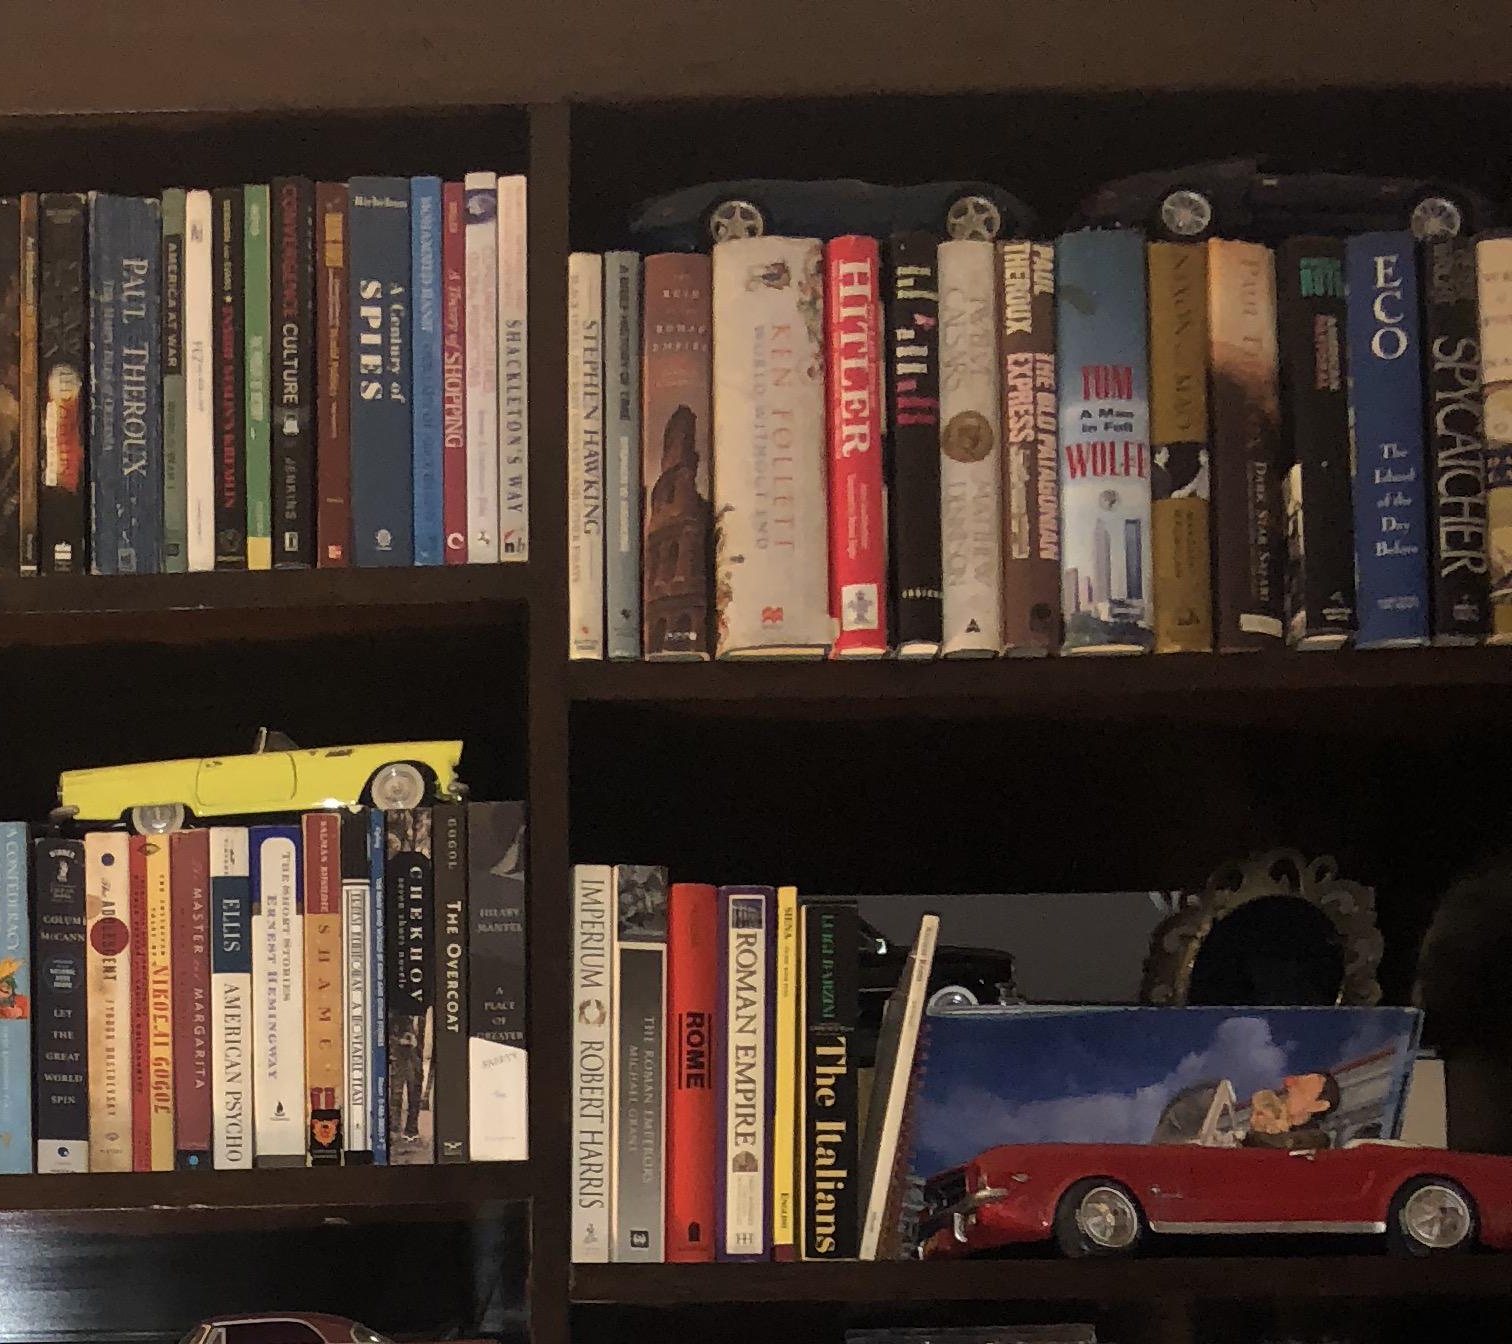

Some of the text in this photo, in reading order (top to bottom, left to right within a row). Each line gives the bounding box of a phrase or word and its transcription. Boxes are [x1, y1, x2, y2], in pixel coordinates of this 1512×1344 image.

[122, 258, 149, 478] PAUL THEROUX
[359, 279, 382, 401] SPIES
[838, 258, 871, 457] HITLER
[1371, 256, 1407, 360] ECO
[1082, 366, 1132, 400] TOM
[504, 463, 524, 515] WAY
[1433, 335, 1487, 576] SPYCATCHER
[223, 897, 241, 953] ELLIS
[409, 866, 423, 1003] CHEKHOV
[580, 880, 605, 988] IMPERIUM
[223, 983, 242, 1163] AMERICAN PSYCHO
[685, 1012, 706, 1089] ROME
[579, 1040, 604, 1209] ROBERT HARRIS
[814, 1037, 847, 1254] The Italians
